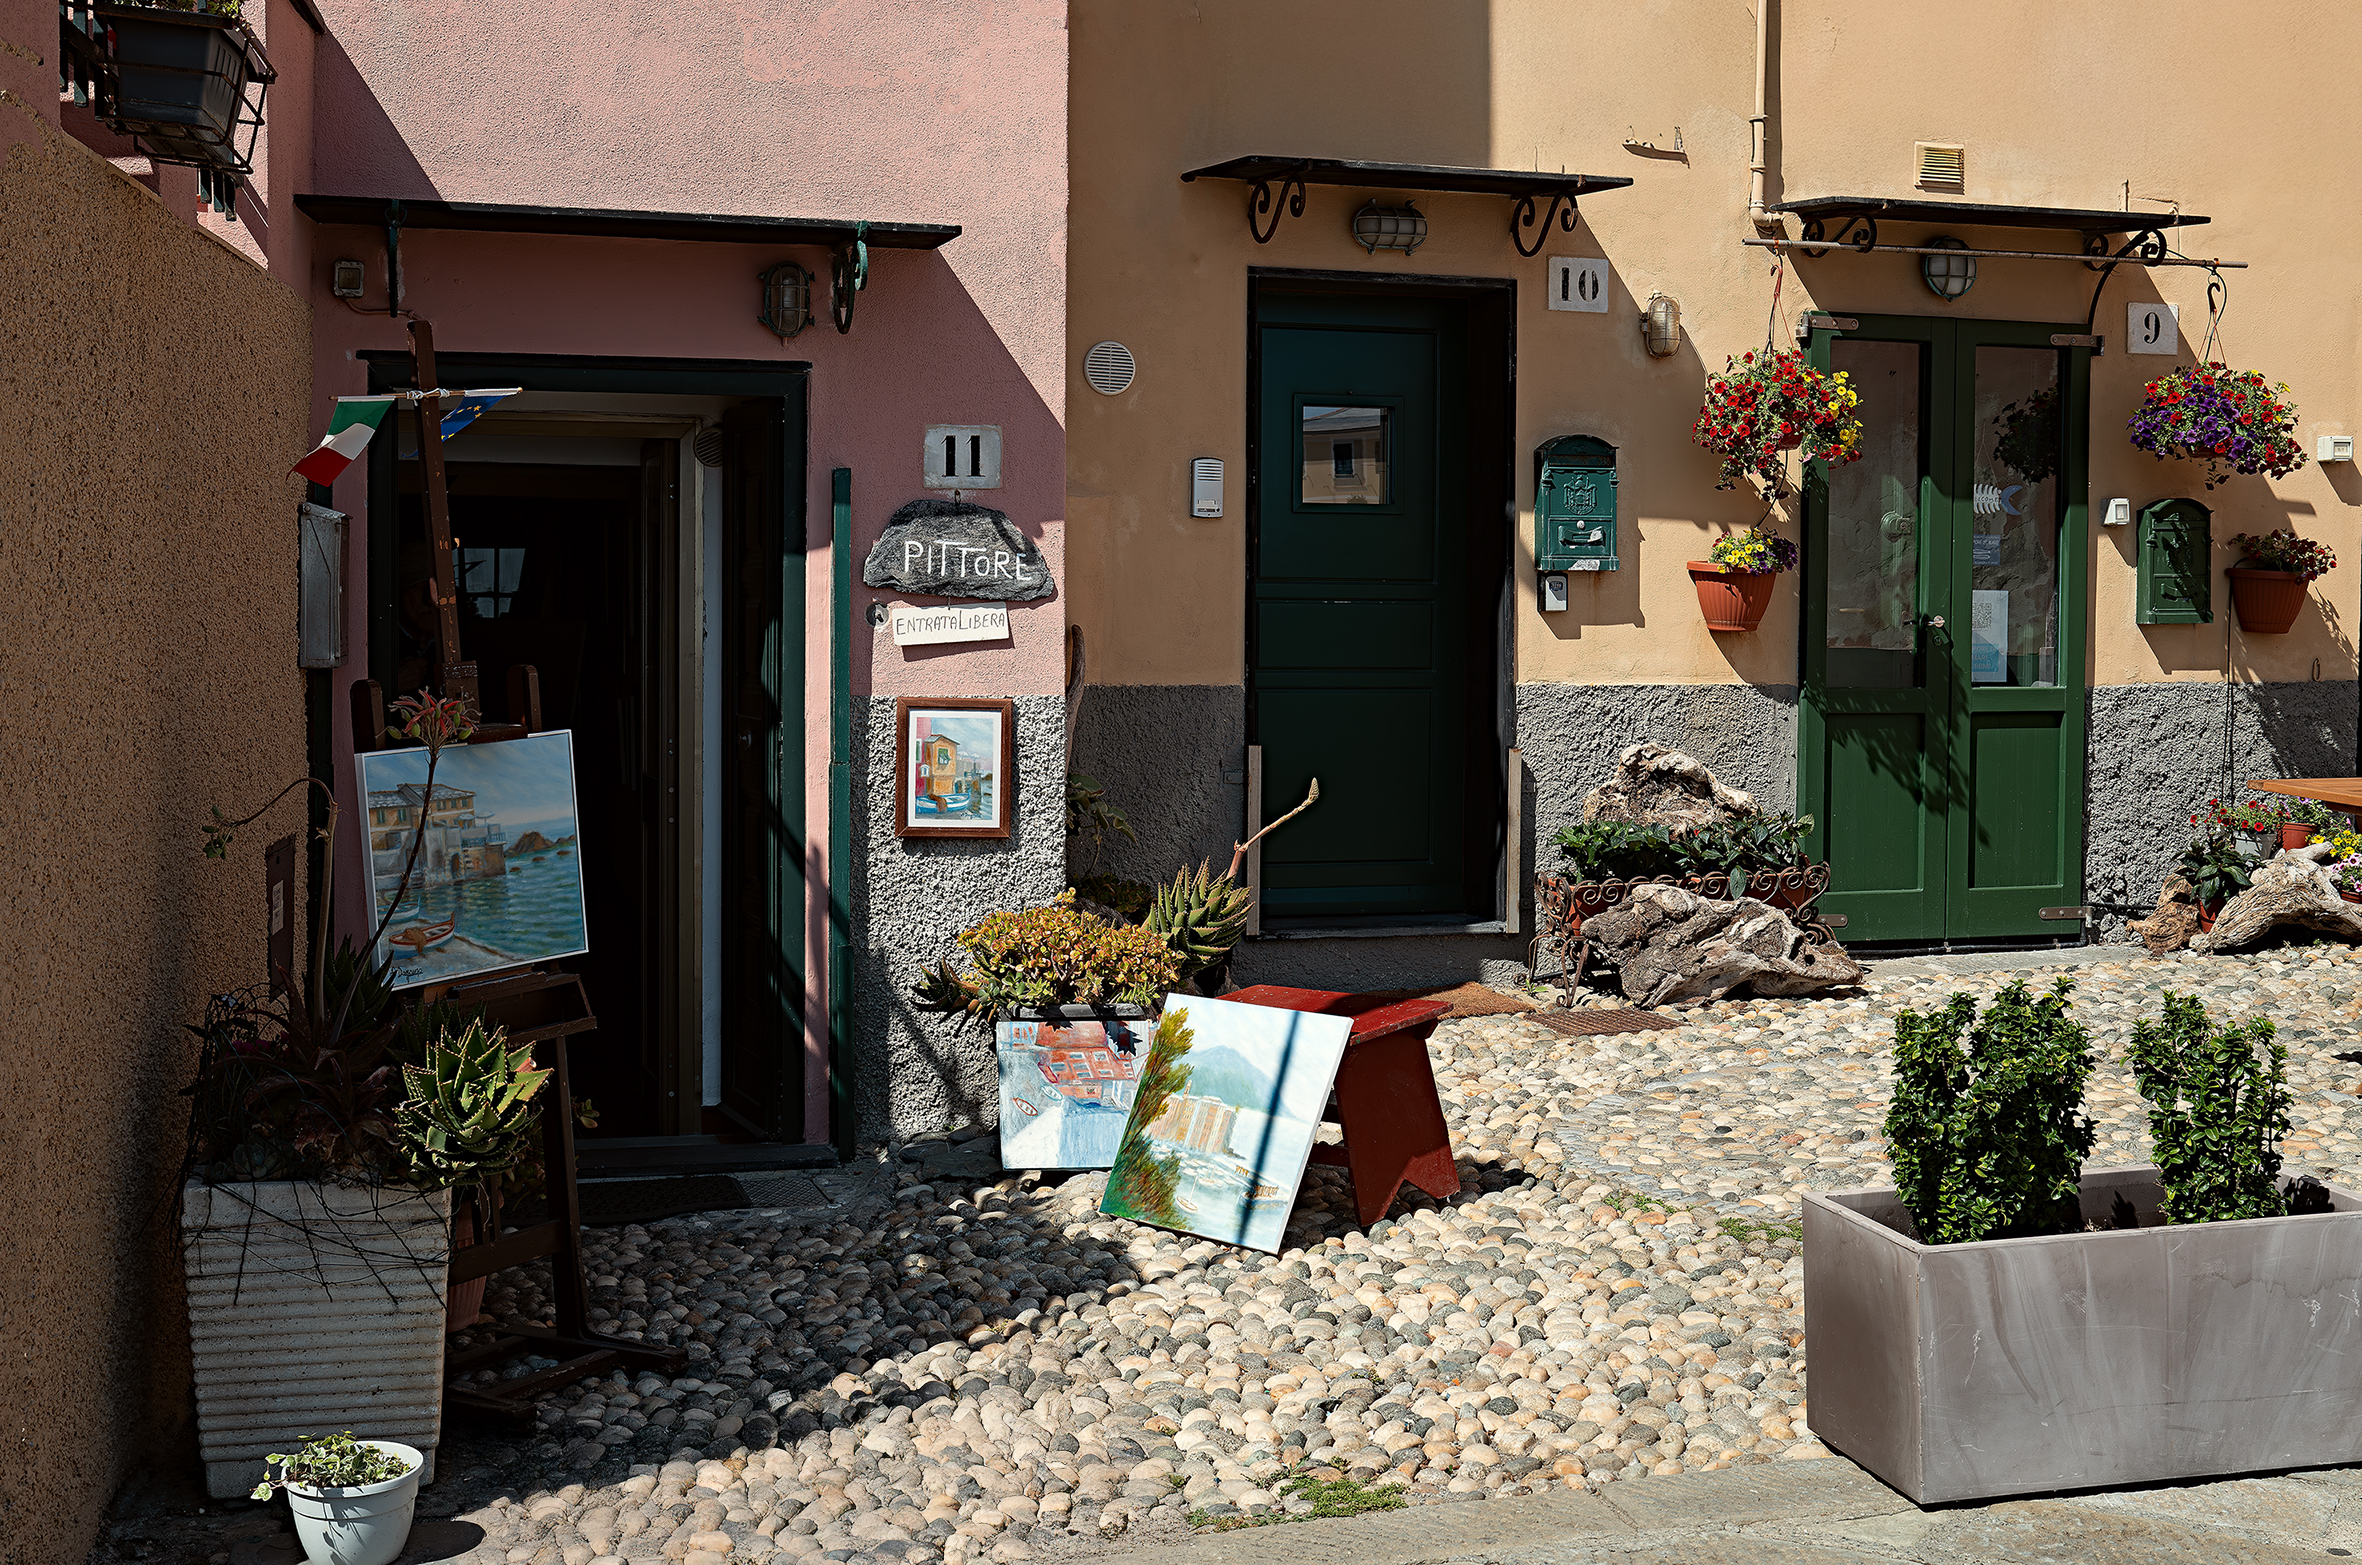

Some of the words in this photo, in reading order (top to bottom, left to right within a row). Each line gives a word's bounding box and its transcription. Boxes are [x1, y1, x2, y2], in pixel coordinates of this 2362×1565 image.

[1560, 266, 1599, 302] 10
[2143, 311, 2161, 345] 9
[940, 434, 985, 478] 11
[904, 539, 1032, 581] PITTORE
